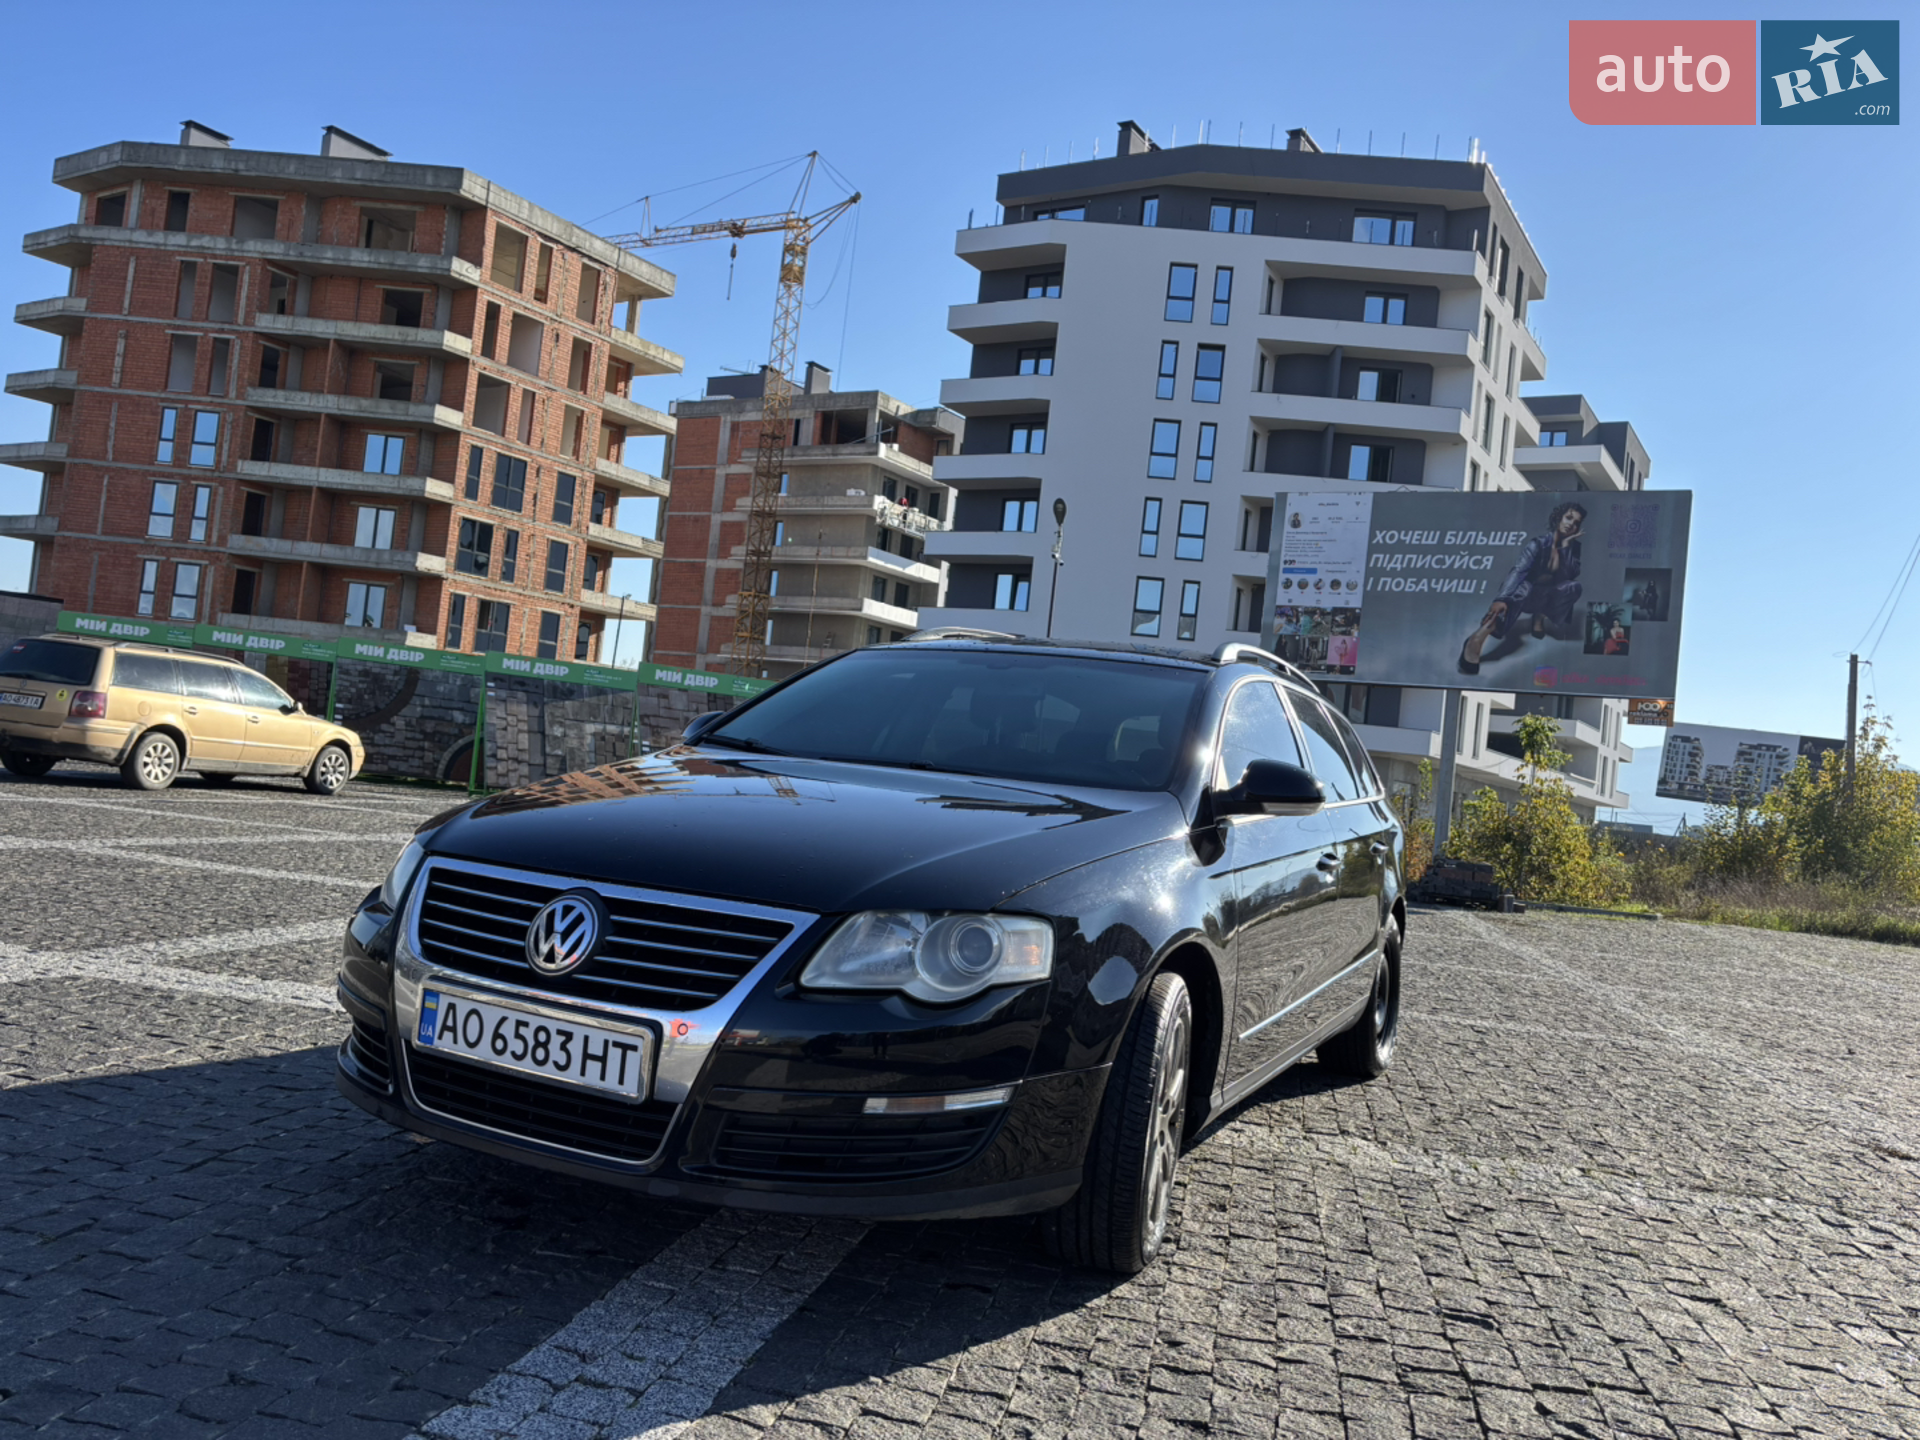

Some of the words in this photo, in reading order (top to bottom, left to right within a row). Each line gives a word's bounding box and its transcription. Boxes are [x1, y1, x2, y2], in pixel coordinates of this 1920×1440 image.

[1372, 530, 1441, 545] ХОЧЕШ
[1443, 530, 1528, 546] БІЛЬШЕ?
[1369, 550, 1494, 571] ПІДПИСУЙСЯ
[1366, 577, 1374, 591] І
[1377, 577, 1477, 594] ПОБАЧИШ
[75, 617, 107, 632] МІЙ
[109, 622, 150, 637] ДВІР
[212, 630, 243, 645] МІЙ
[245, 635, 285, 650] ДВІР
[354, 643, 384, 657] МІЙ
[386, 648, 425, 662] ДВІР
[502, 658, 531, 672] МІЙ
[533, 661, 569, 677] ДВІР
[655, 668, 682, 683] МІЙ
[684, 673, 719, 688] ДВІР
[530, 898, 595, 971] VW
[420, 1023, 433, 1038] UA
[437, 1002, 484, 1048] AO
[490, 1016, 574, 1072] 6583
[580, 1034, 639, 1086] HT
